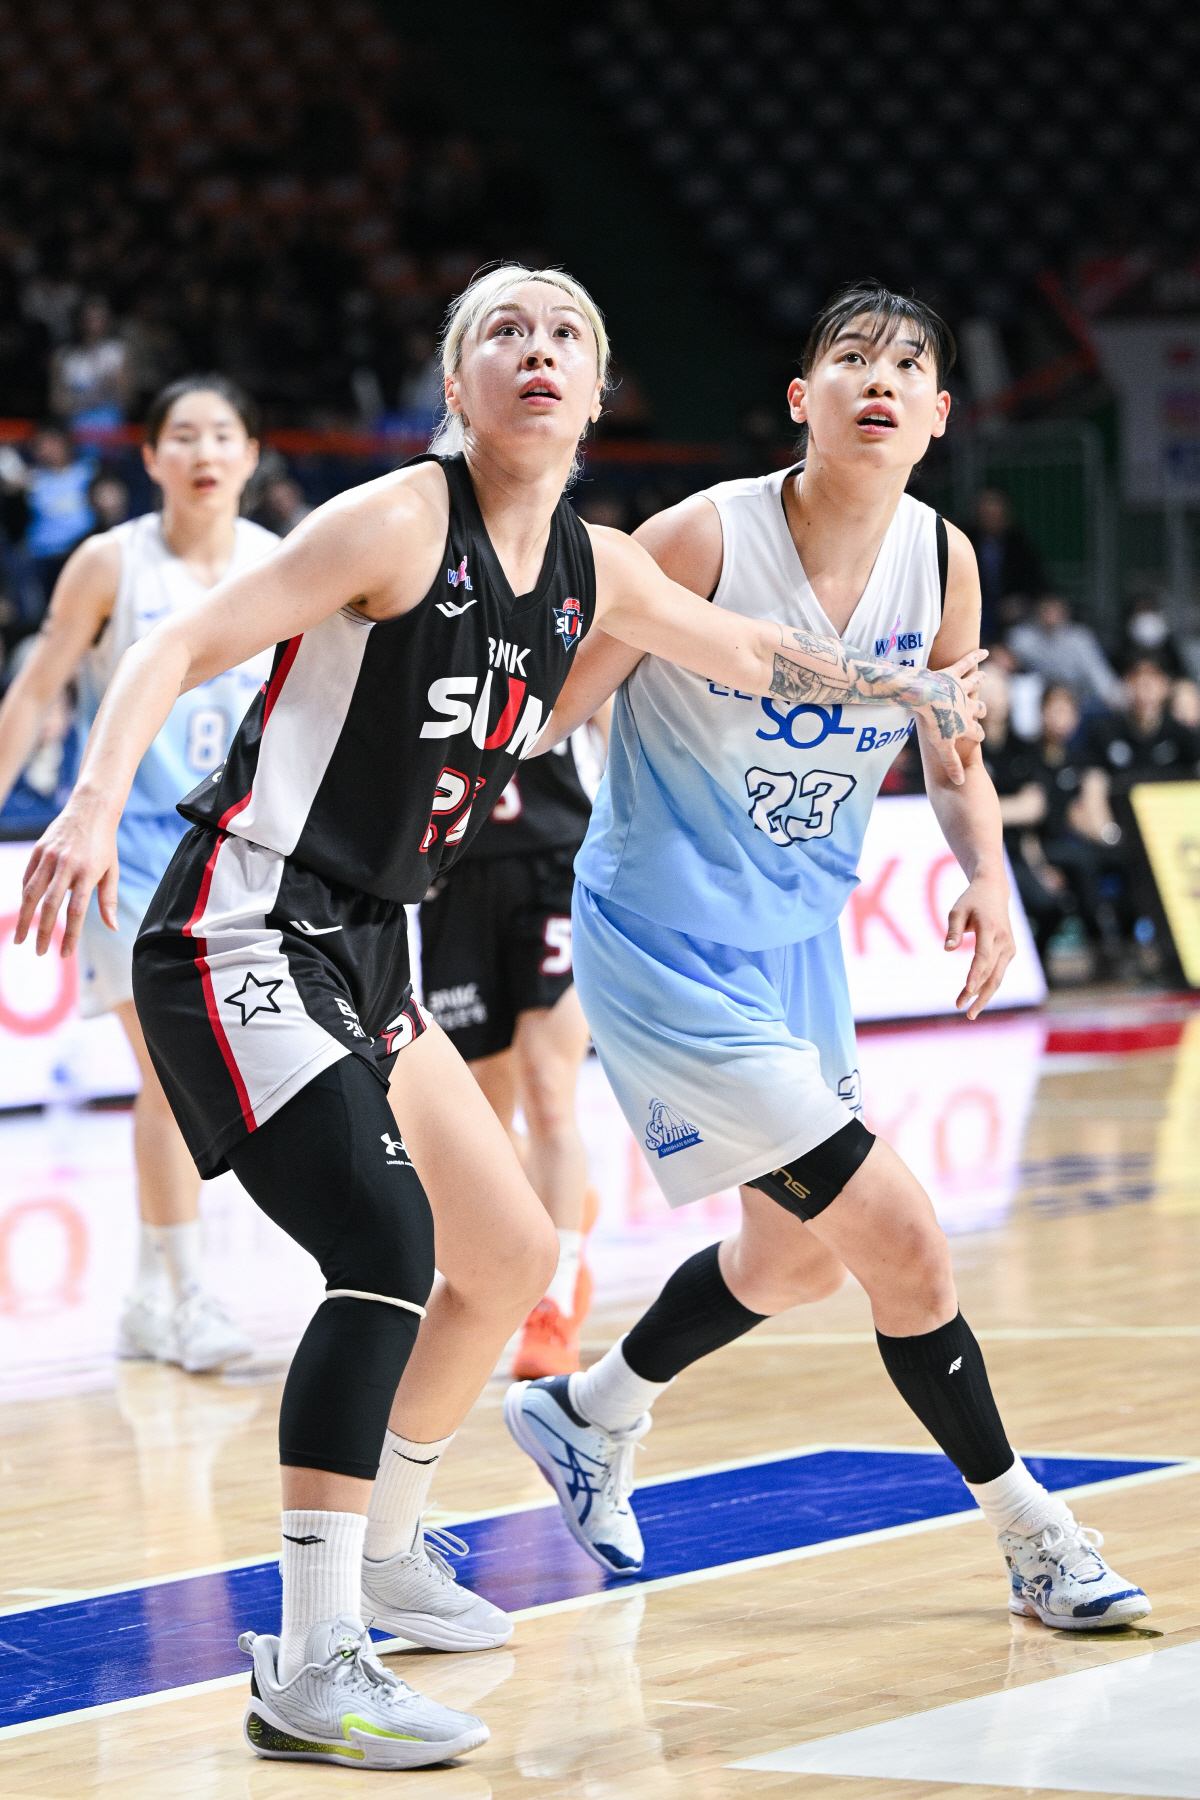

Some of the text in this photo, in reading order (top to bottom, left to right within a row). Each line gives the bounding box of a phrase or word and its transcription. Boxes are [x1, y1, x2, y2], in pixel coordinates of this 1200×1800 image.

[188, 707, 229, 773] 8
[745, 766, 858, 847] 23
[539, 914, 573, 976] 5
